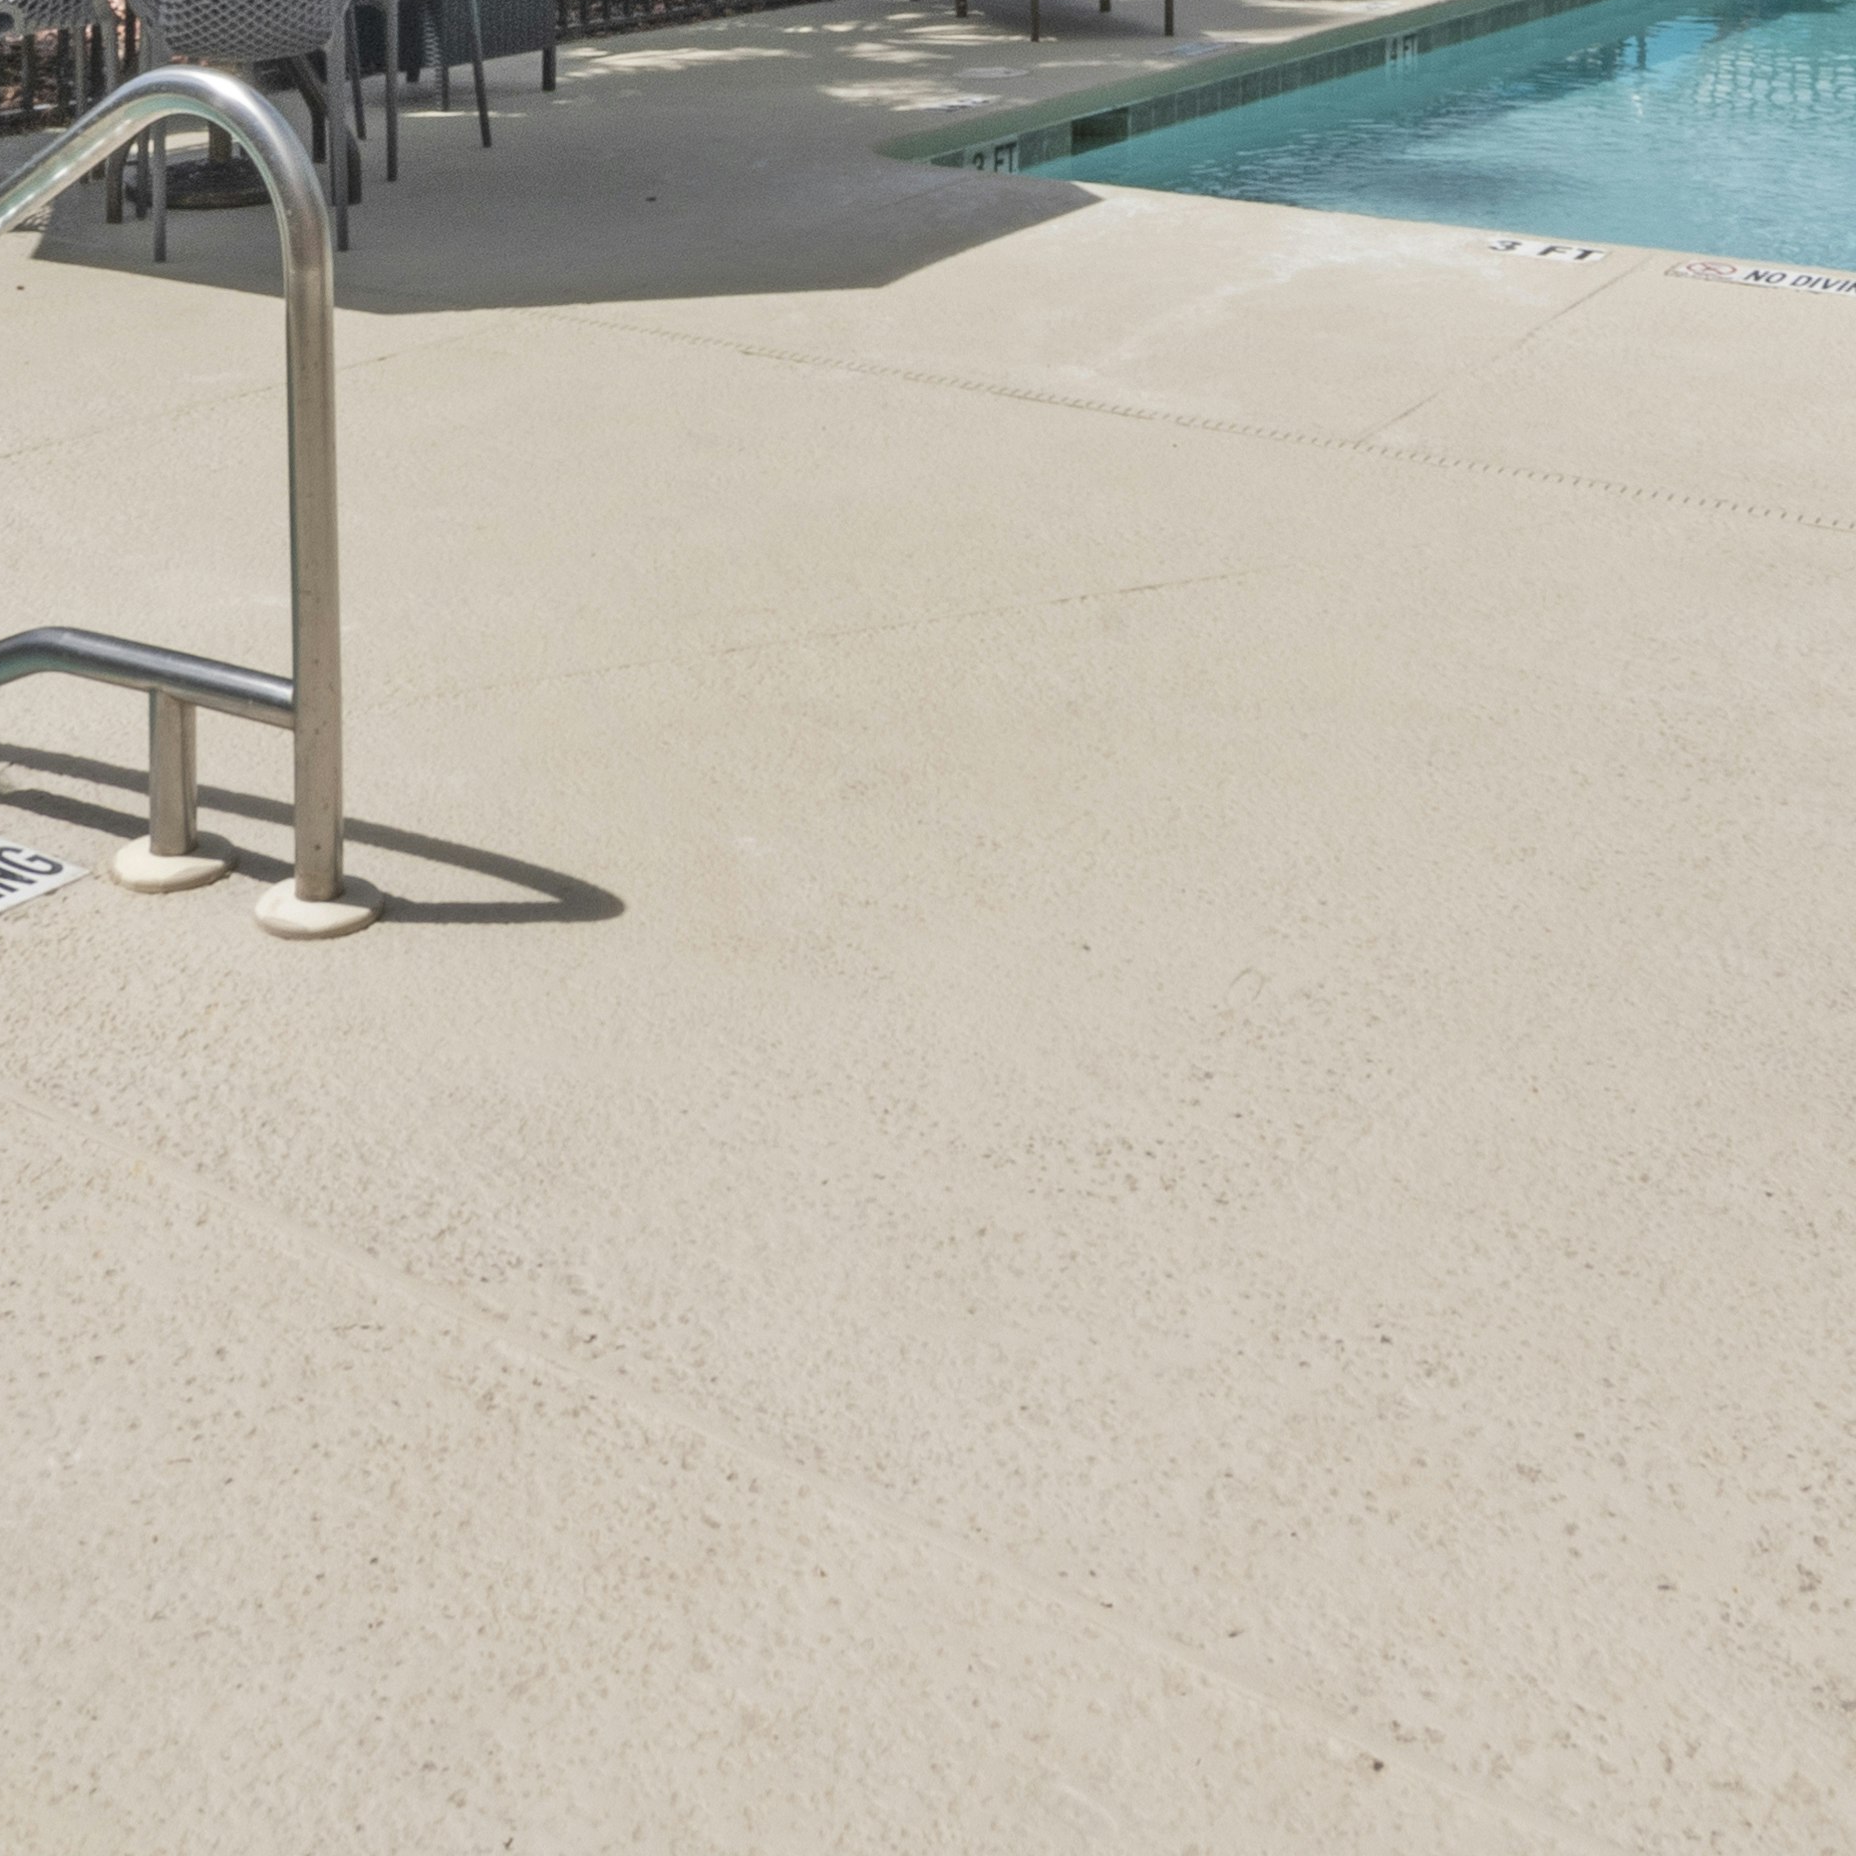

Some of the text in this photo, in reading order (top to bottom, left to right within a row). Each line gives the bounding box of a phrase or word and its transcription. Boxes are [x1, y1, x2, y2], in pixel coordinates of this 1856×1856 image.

[994, 141, 1017, 173] FT
[1489, 240, 1604, 261] 3 FT
[1744, 269, 1787, 284] NO
